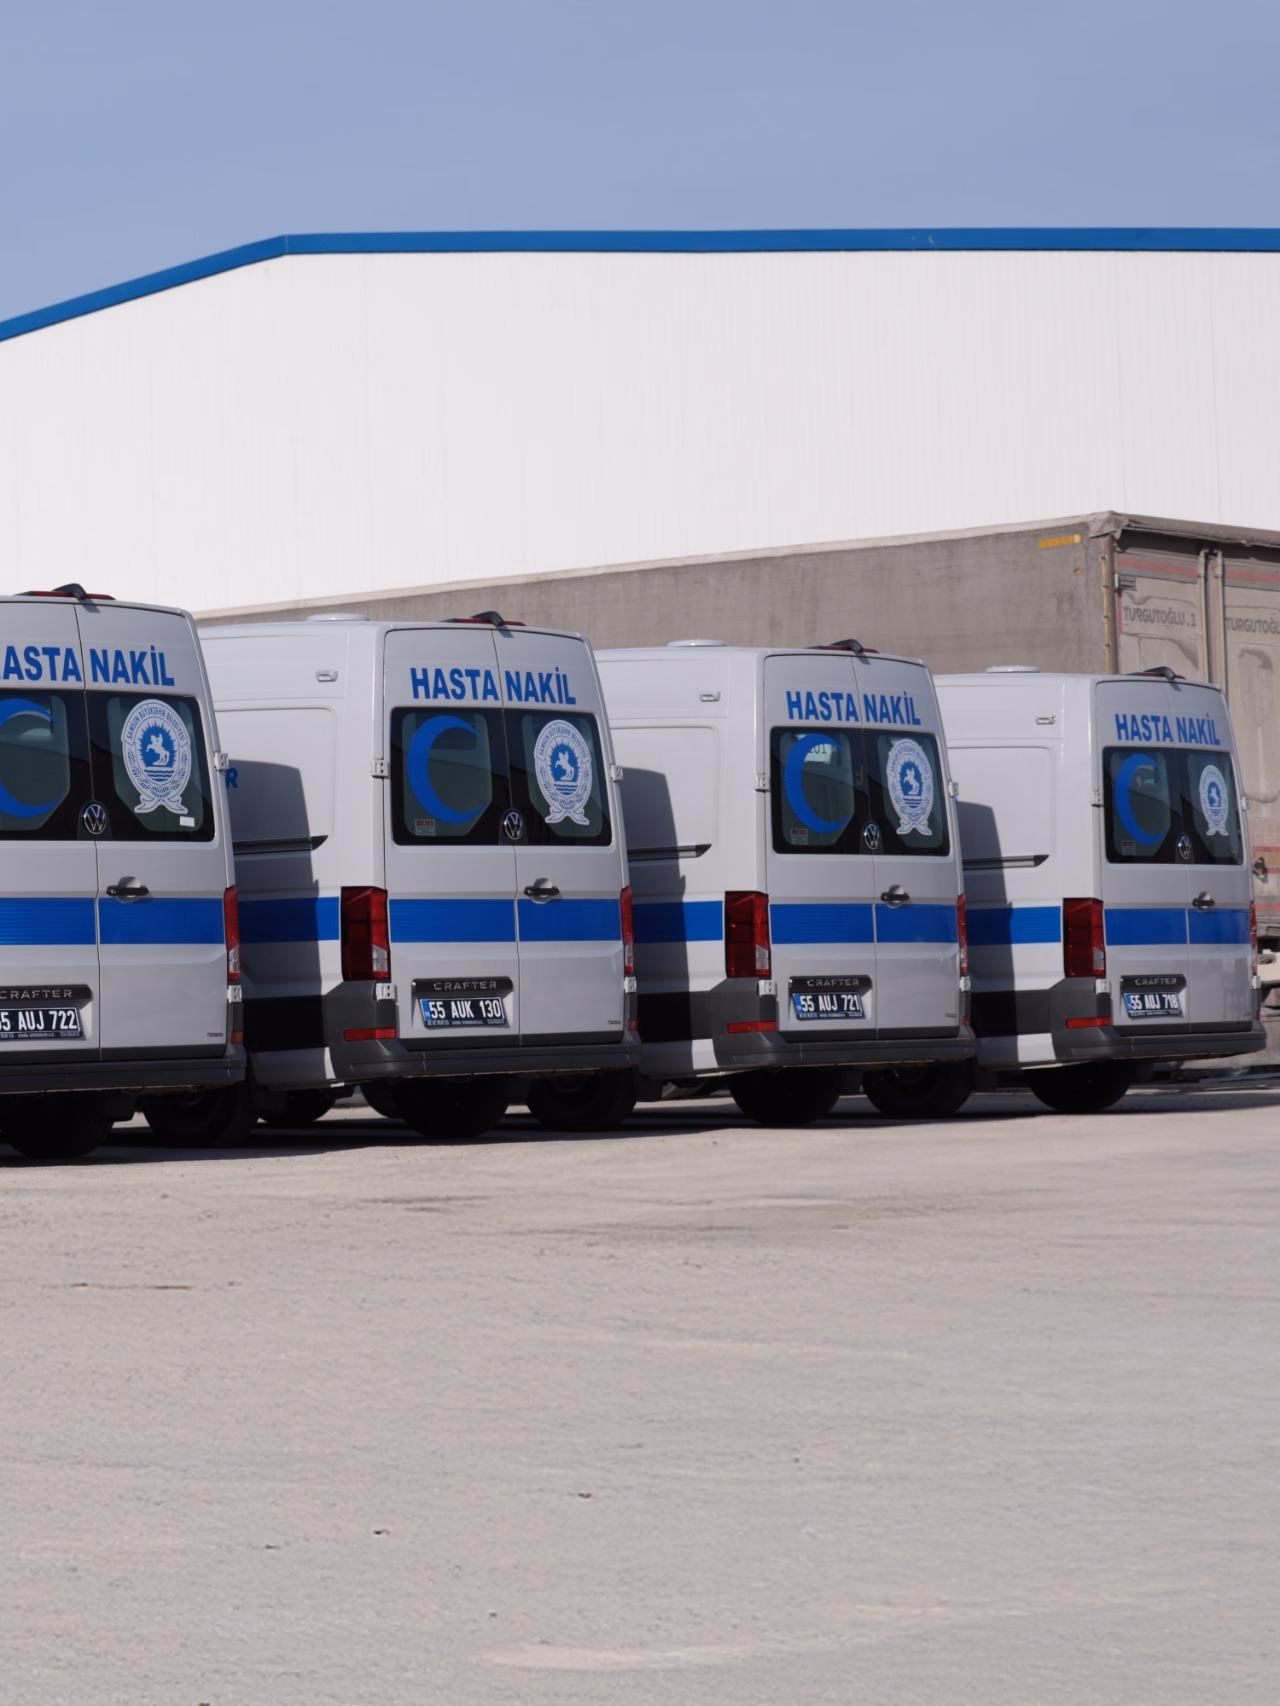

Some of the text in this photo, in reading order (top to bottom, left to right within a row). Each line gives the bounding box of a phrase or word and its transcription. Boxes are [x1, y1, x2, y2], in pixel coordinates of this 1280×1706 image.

[90, 645, 175, 686] NAKİL
[410, 666, 576, 705] HASTA NAKİL
[786, 691, 921, 725] HASTA NAKİL
[1114, 713, 1220, 746] HASTA NAKİL
[433, 981, 497, 991] CRAFTER
[807, 979, 859, 987] CRAFTER
[428, 1000, 501, 1019] 55 AUK 130
[799, 994, 860, 1012] 55 AUJ 721
[1129, 994, 1143, 1010] 55
[18, 1011, 45, 1031] AUJ
[49, 1010, 78, 1030] 722
